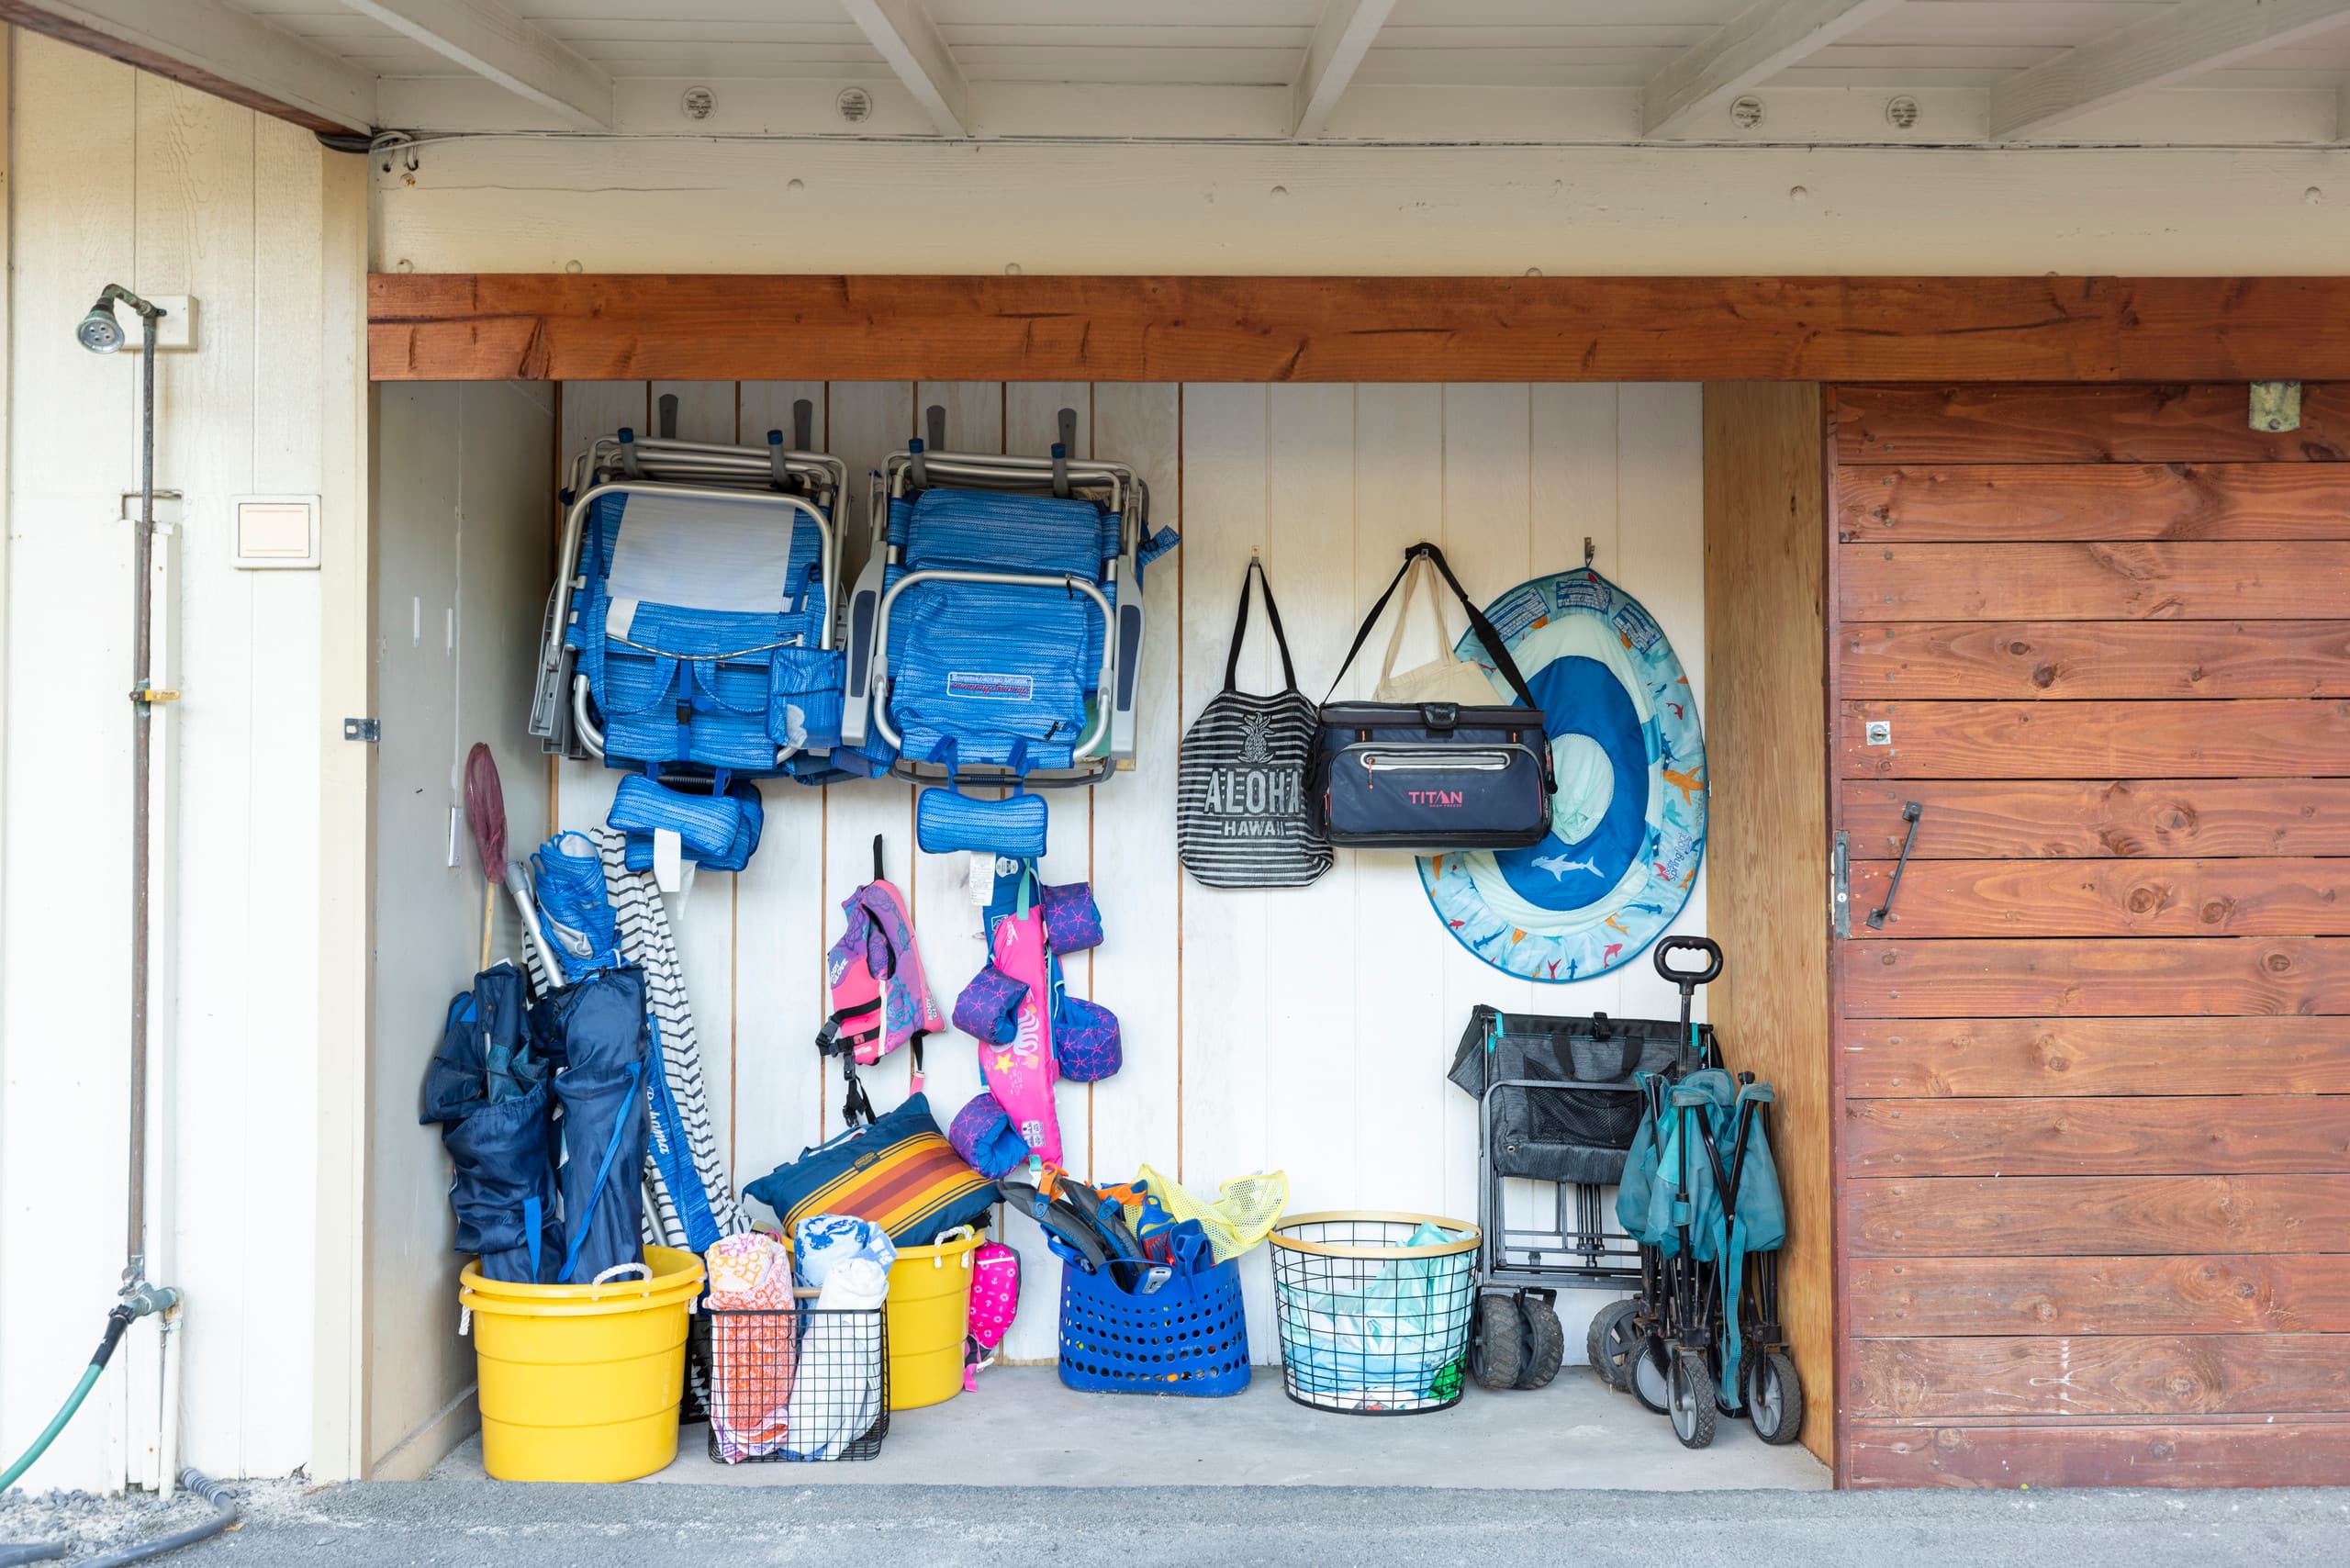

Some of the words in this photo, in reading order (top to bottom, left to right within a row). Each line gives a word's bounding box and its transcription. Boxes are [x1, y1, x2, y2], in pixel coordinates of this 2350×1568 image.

[1203, 770, 1300, 813] ALOHA
[1408, 790, 1462, 804] TITAN
[1224, 821, 1285, 836] HAWAII
